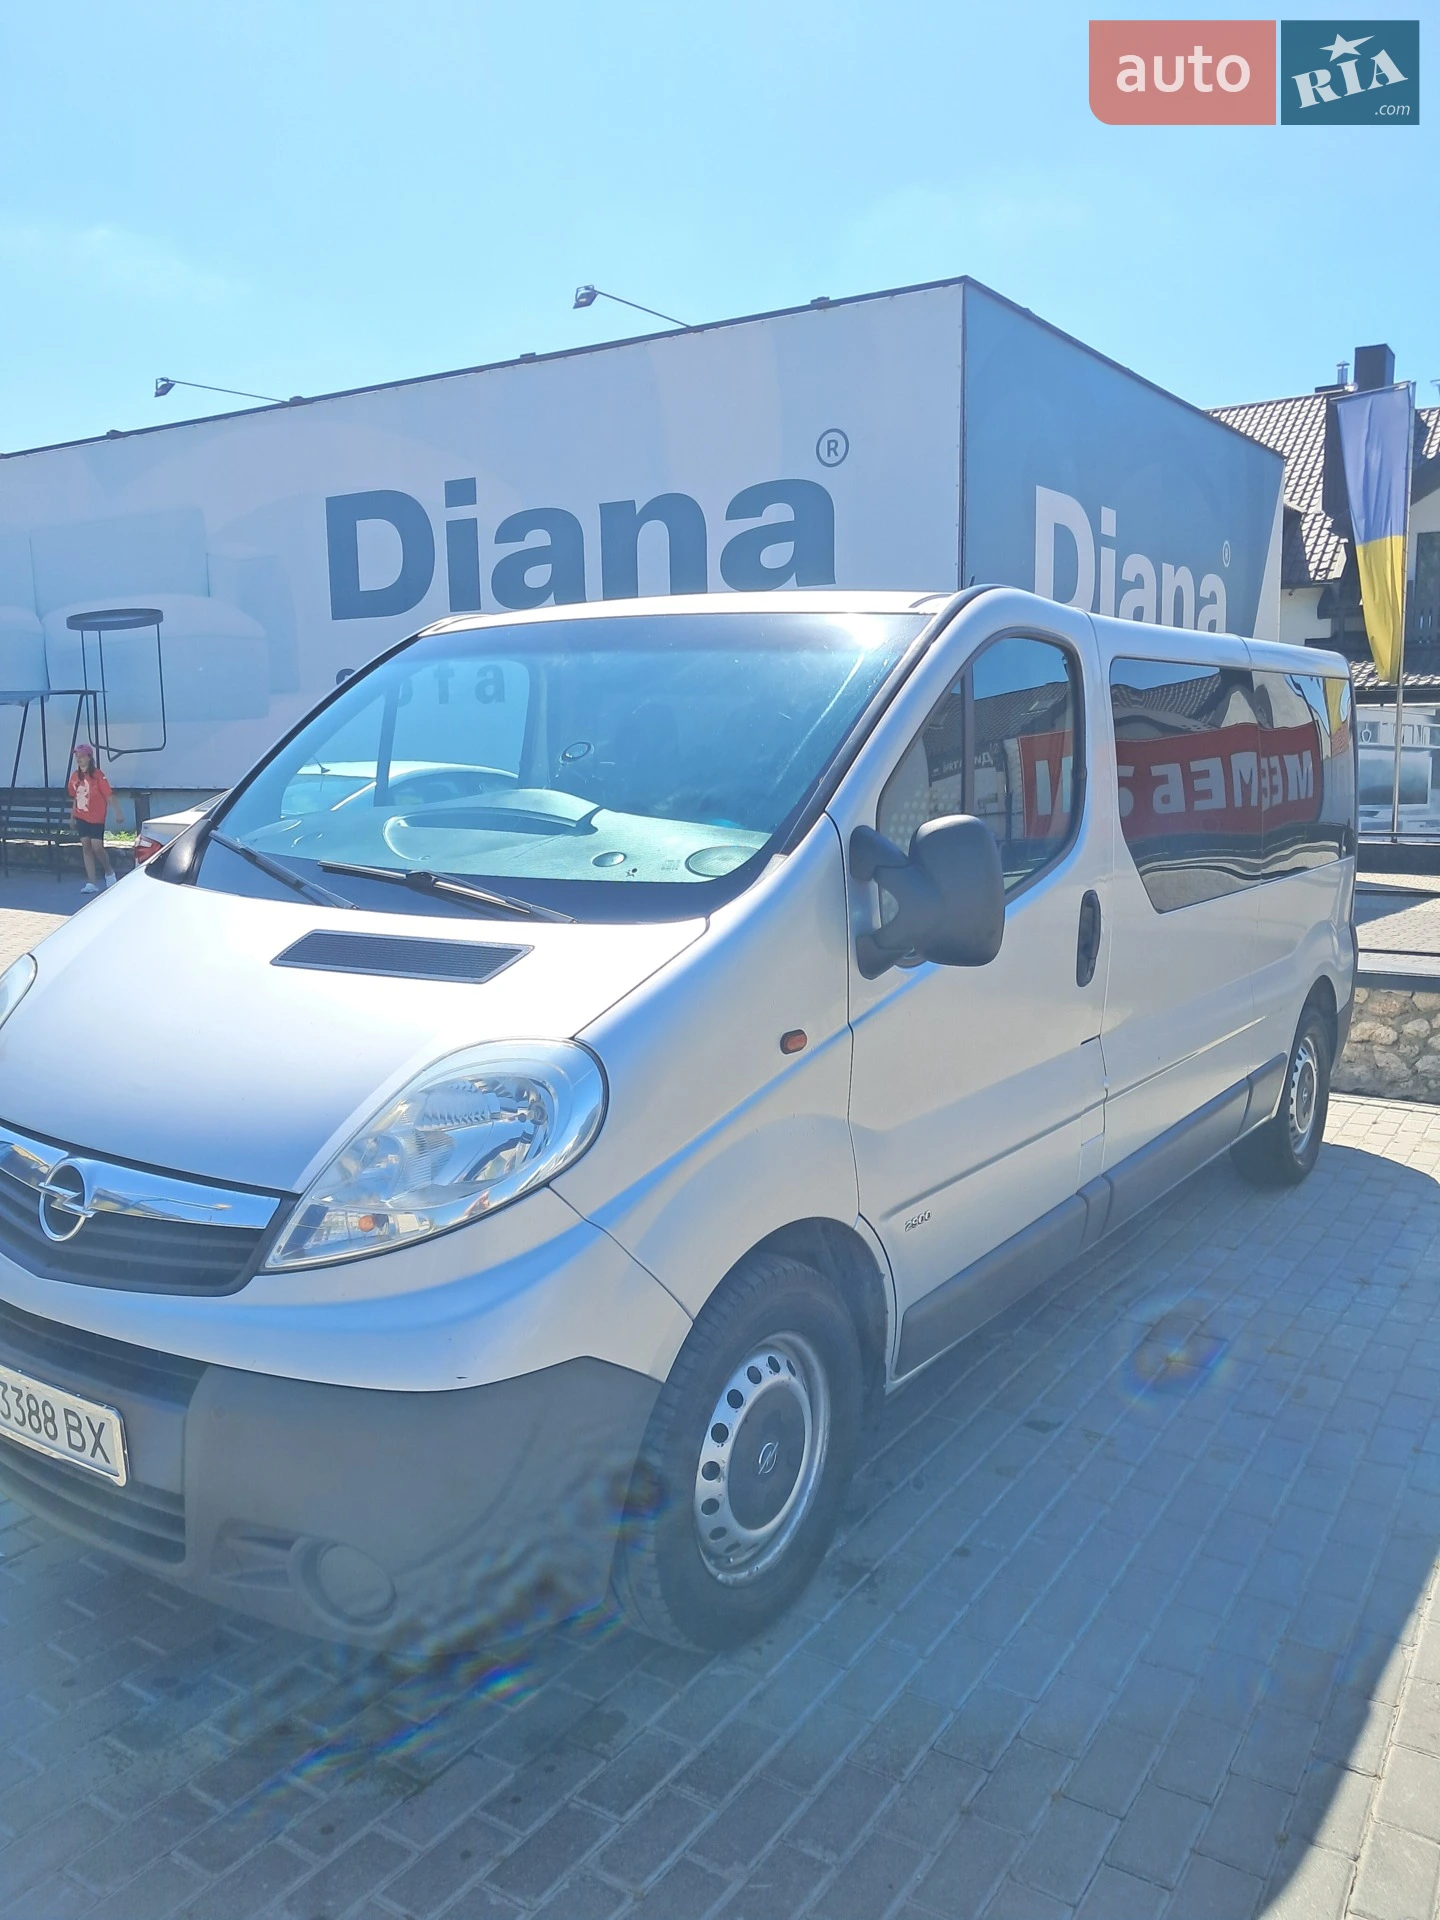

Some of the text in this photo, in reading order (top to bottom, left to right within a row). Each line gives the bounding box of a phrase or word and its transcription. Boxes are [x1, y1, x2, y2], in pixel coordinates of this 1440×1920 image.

[325, 477, 836, 620] Diana
[1035, 485, 1227, 635] Diana
[63, 1408, 112, 1465] BX
